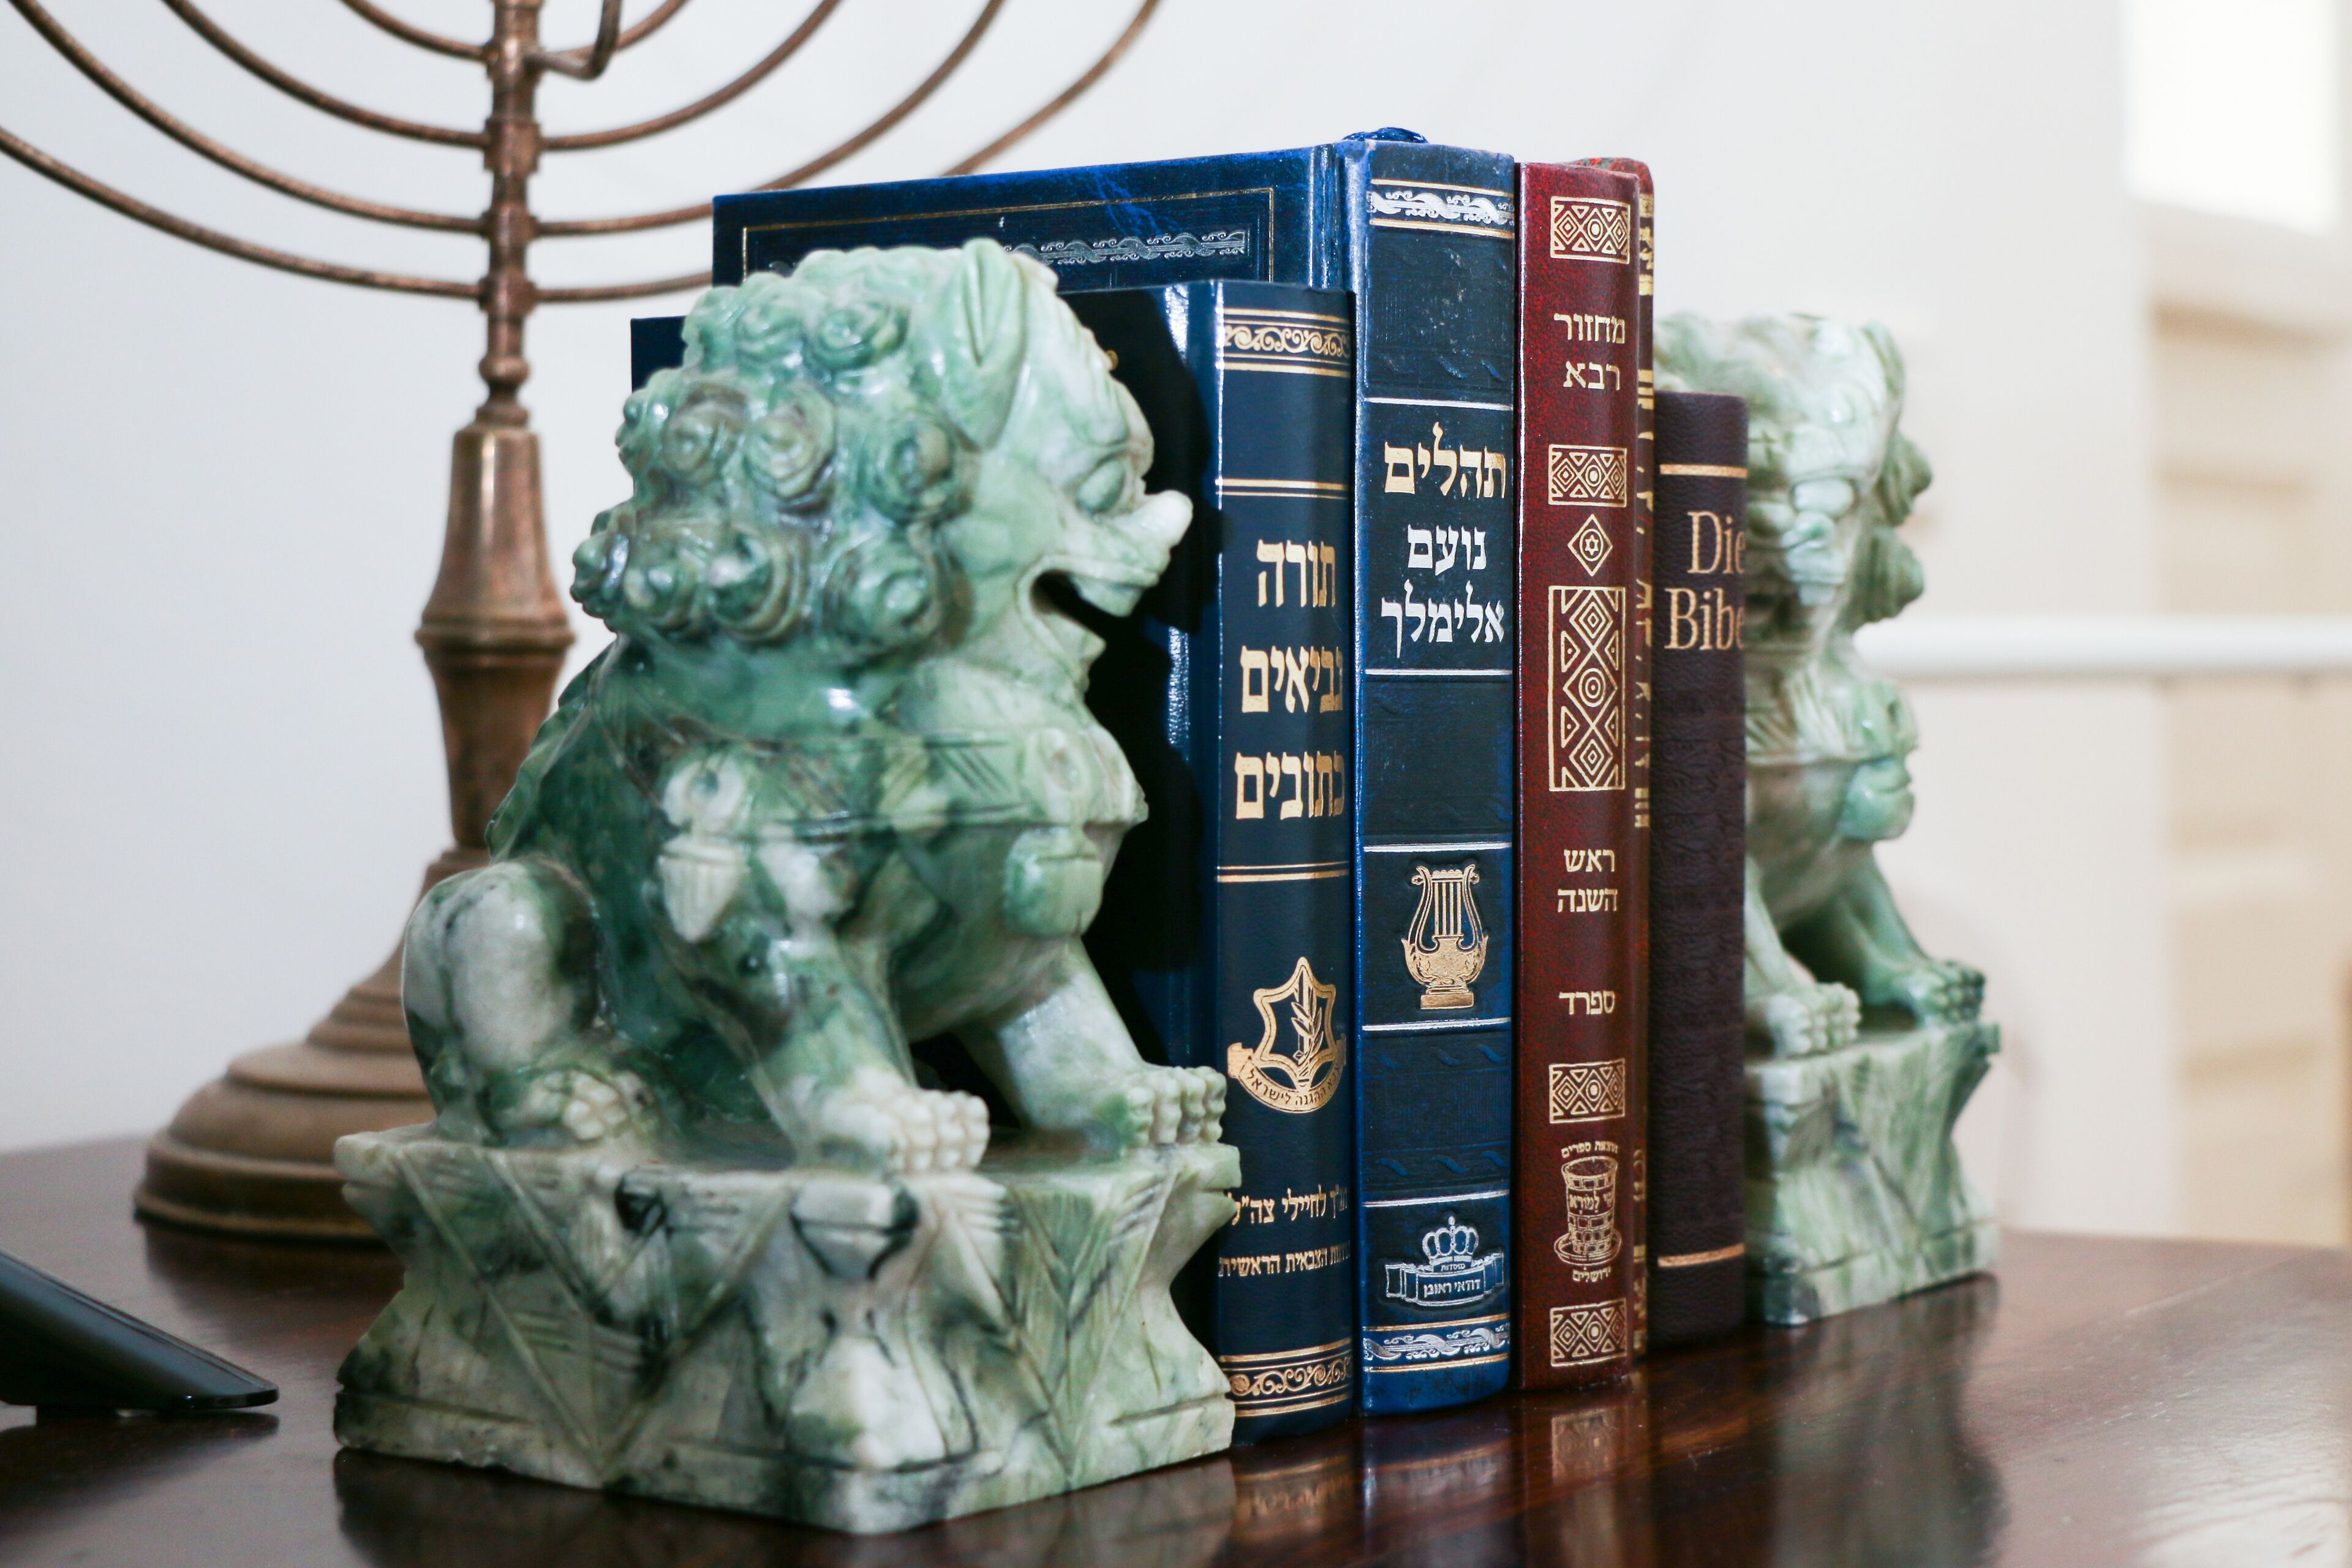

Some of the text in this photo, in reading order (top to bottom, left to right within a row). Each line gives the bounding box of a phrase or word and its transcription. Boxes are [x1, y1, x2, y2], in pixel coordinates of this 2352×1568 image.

[1553, 312, 1626, 344] מחזור
[1562, 360, 1620, 391] רבא
[1384, 421, 1506, 499] תהלים
[1408, 524, 1487, 576] נועם
[1687, 510, 1746, 574] Die
[1256, 539, 1336, 608] תורה
[1381, 579, 1505, 659] אלימלך
[1240, 645, 1343, 713] נביאים
[1234, 750, 1345, 820] כתובים
[1563, 849, 1615, 872] ראש
[1557, 889, 1618, 913] השנה
[1558, 990, 1616, 1015] ספרד
[1246, 1068, 1291, 1104] לישראל
[1561, 1141, 1592, 1158] ספרים
[1281, 1183, 1327, 1221] לחיילי
[1218, 1255, 1281, 1277] הראשית
